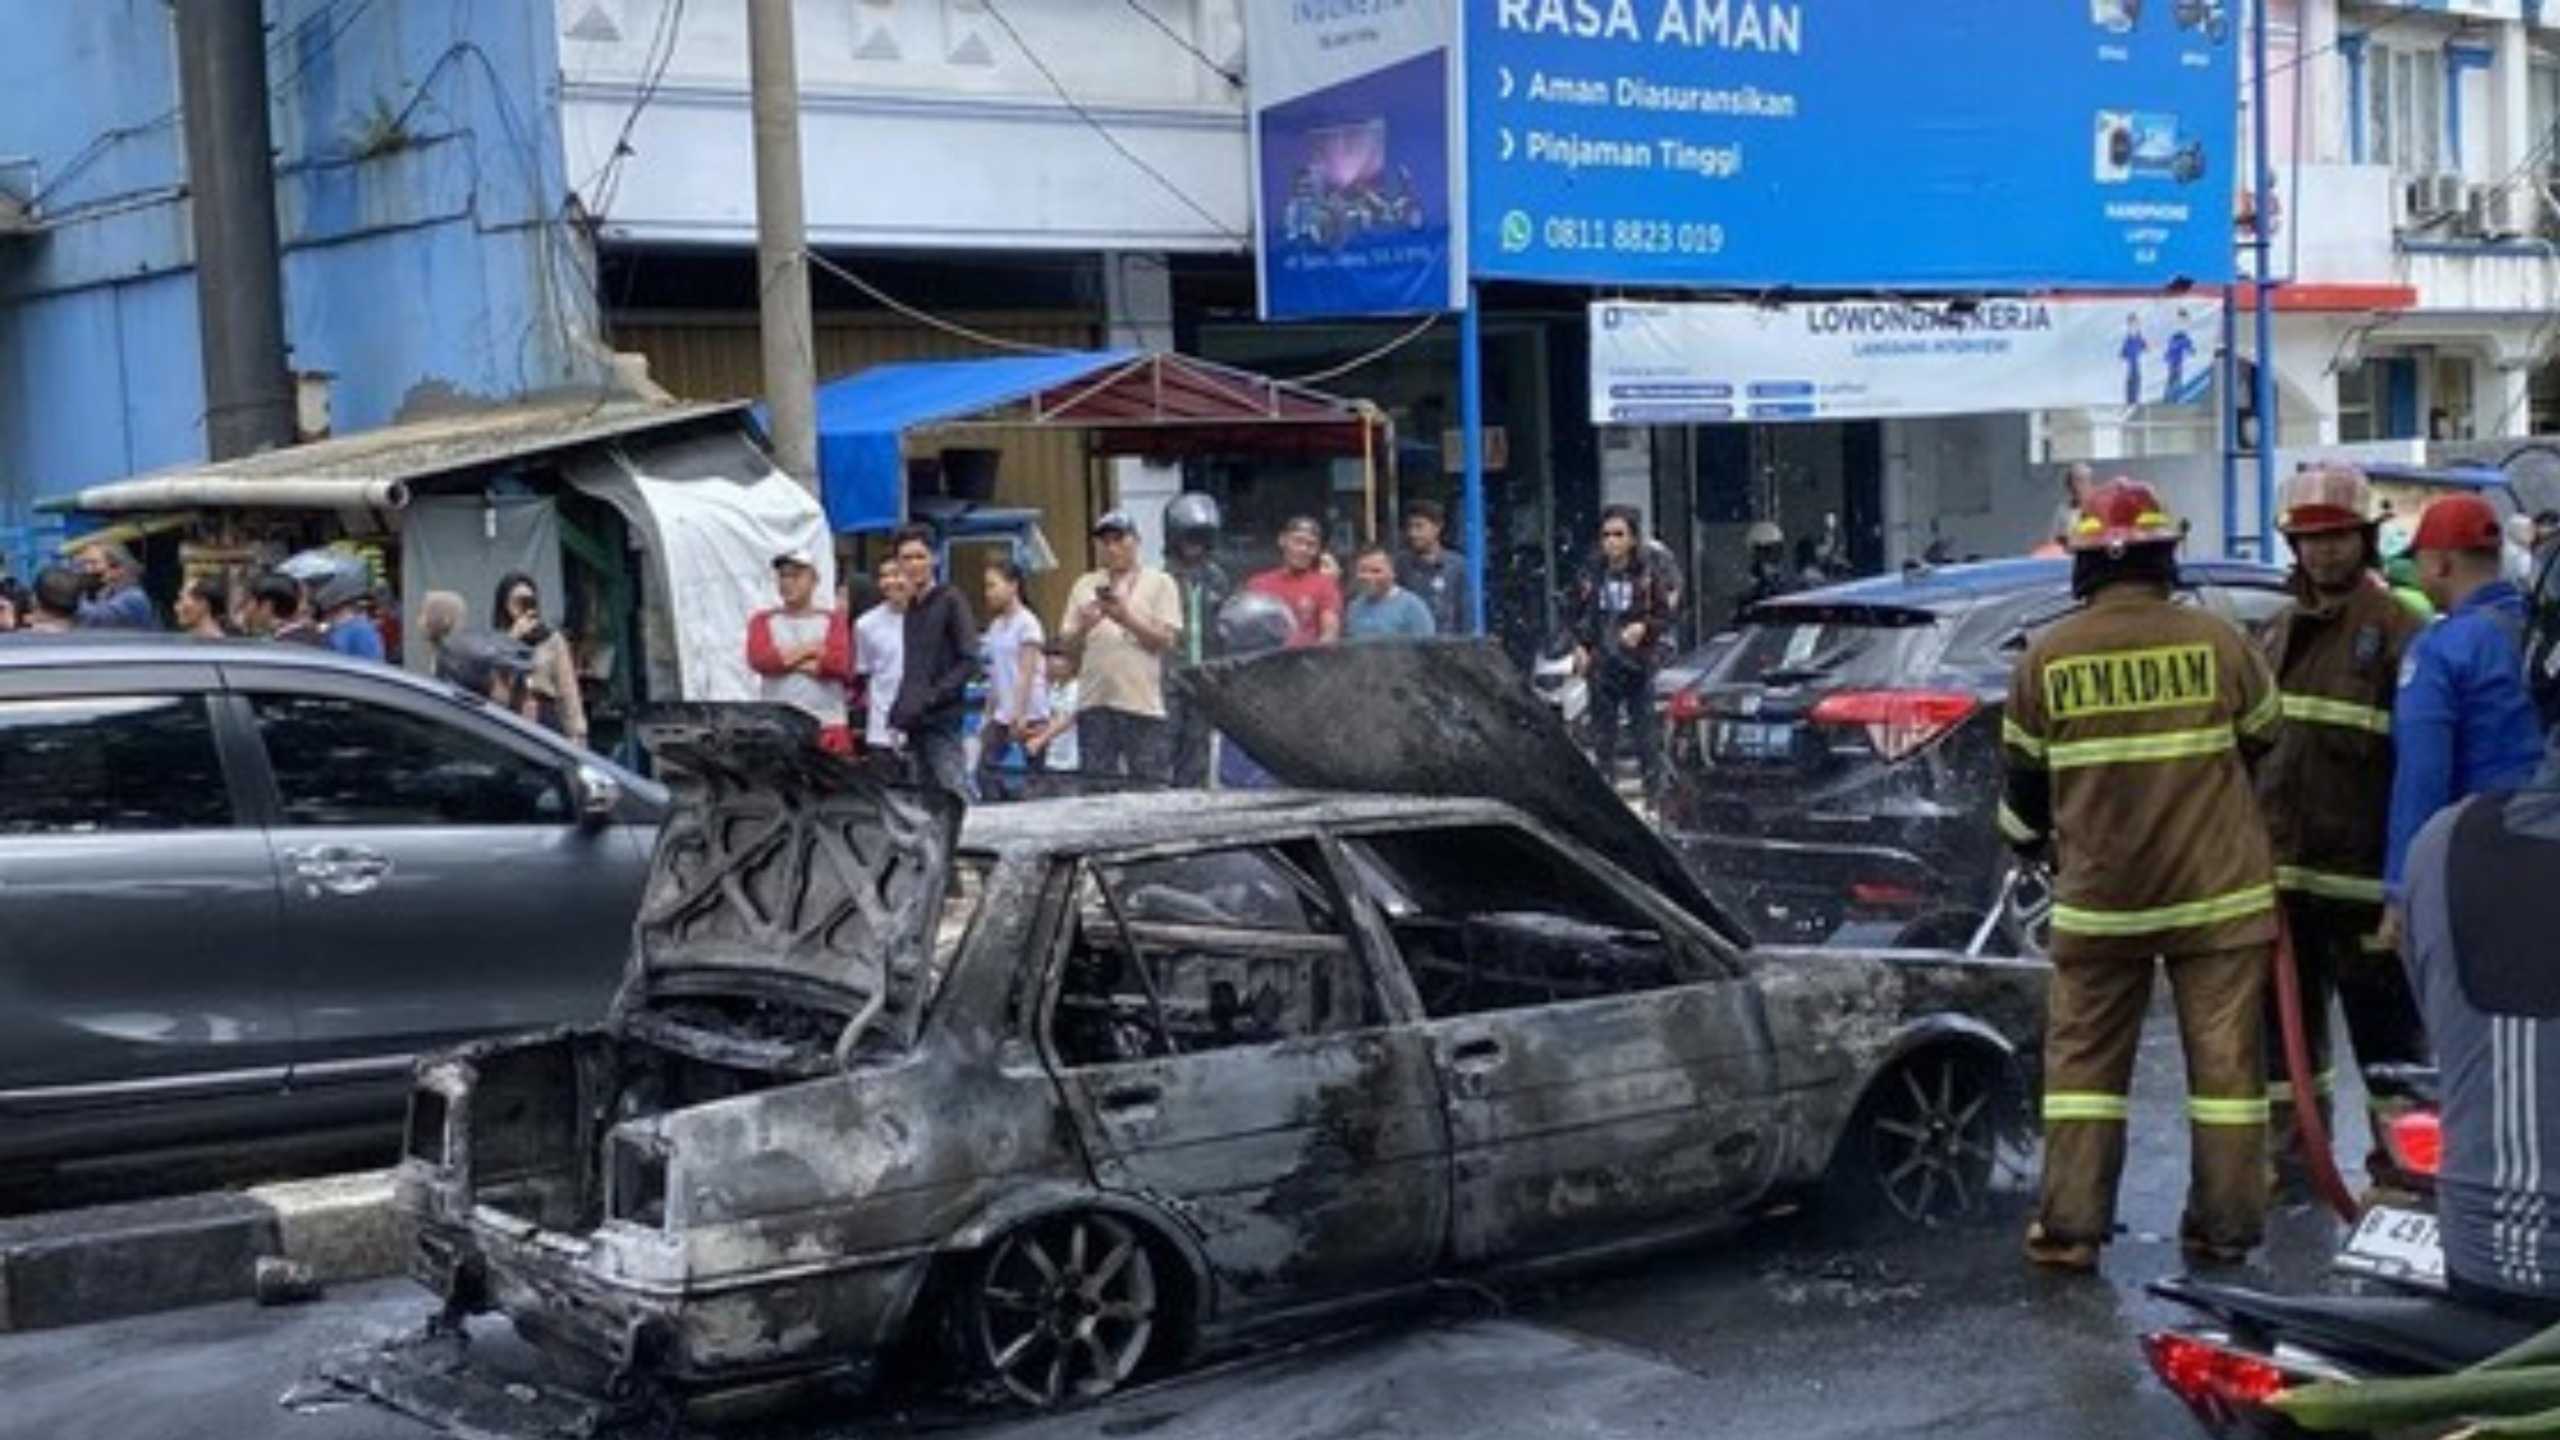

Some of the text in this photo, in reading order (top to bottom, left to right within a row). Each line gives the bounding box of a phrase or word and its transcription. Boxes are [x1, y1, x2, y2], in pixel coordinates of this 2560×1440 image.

[1498, 0, 1800, 54] RASA AMAN
[1528, 71, 1797, 117] Aman Diasuransikan
[1526, 130, 1742, 177] Pinjaman Tinggi
[1544, 216, 1725, 253] 0811 8823 019
[1973, 302, 2052, 330] KERJA
[2051, 650, 2208, 712] PEMADAM
